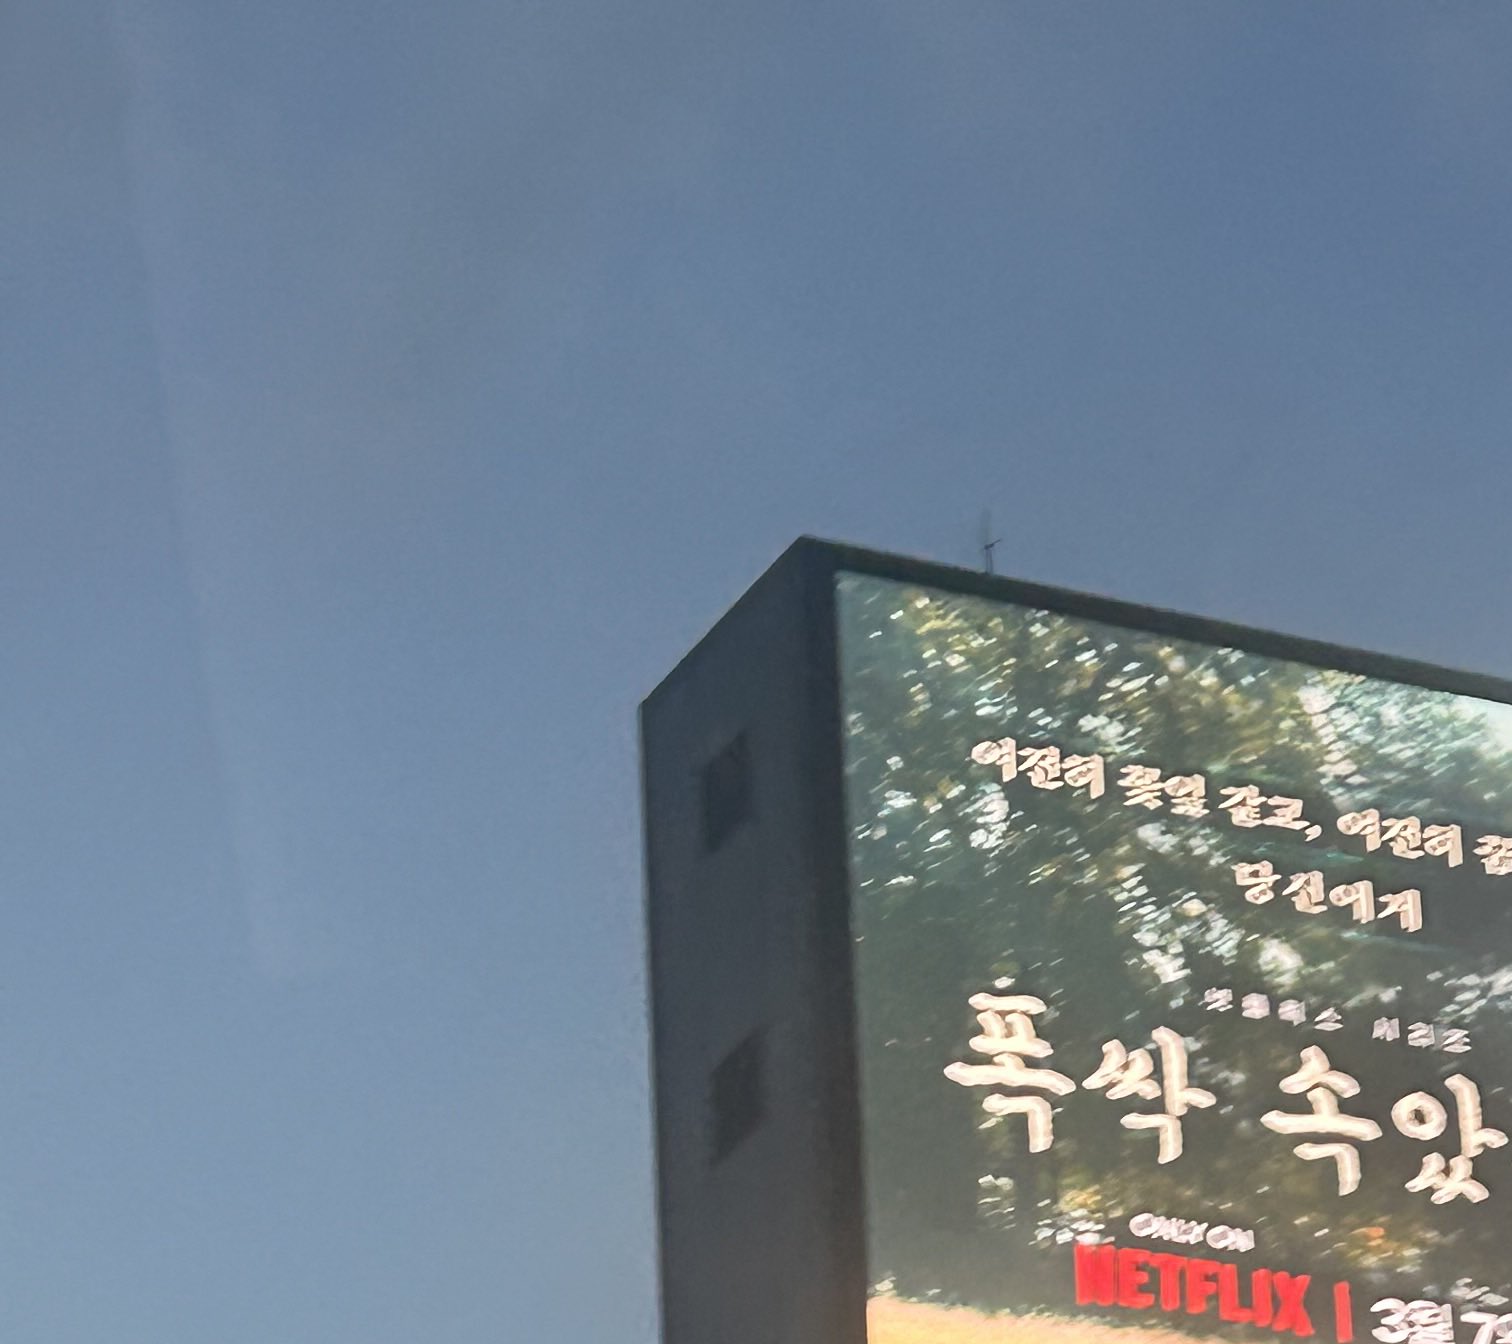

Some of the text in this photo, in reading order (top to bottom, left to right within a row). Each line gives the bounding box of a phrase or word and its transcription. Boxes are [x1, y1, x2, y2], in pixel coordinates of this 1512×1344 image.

[971, 737, 1105, 799] 여전히
[1337, 808, 1463, 868] 여전히
[1230, 860, 1423, 933] 당신에게
[943, 992, 1217, 1164] 폭싹
[1074, 1243, 1315, 1337] NETFLIX
